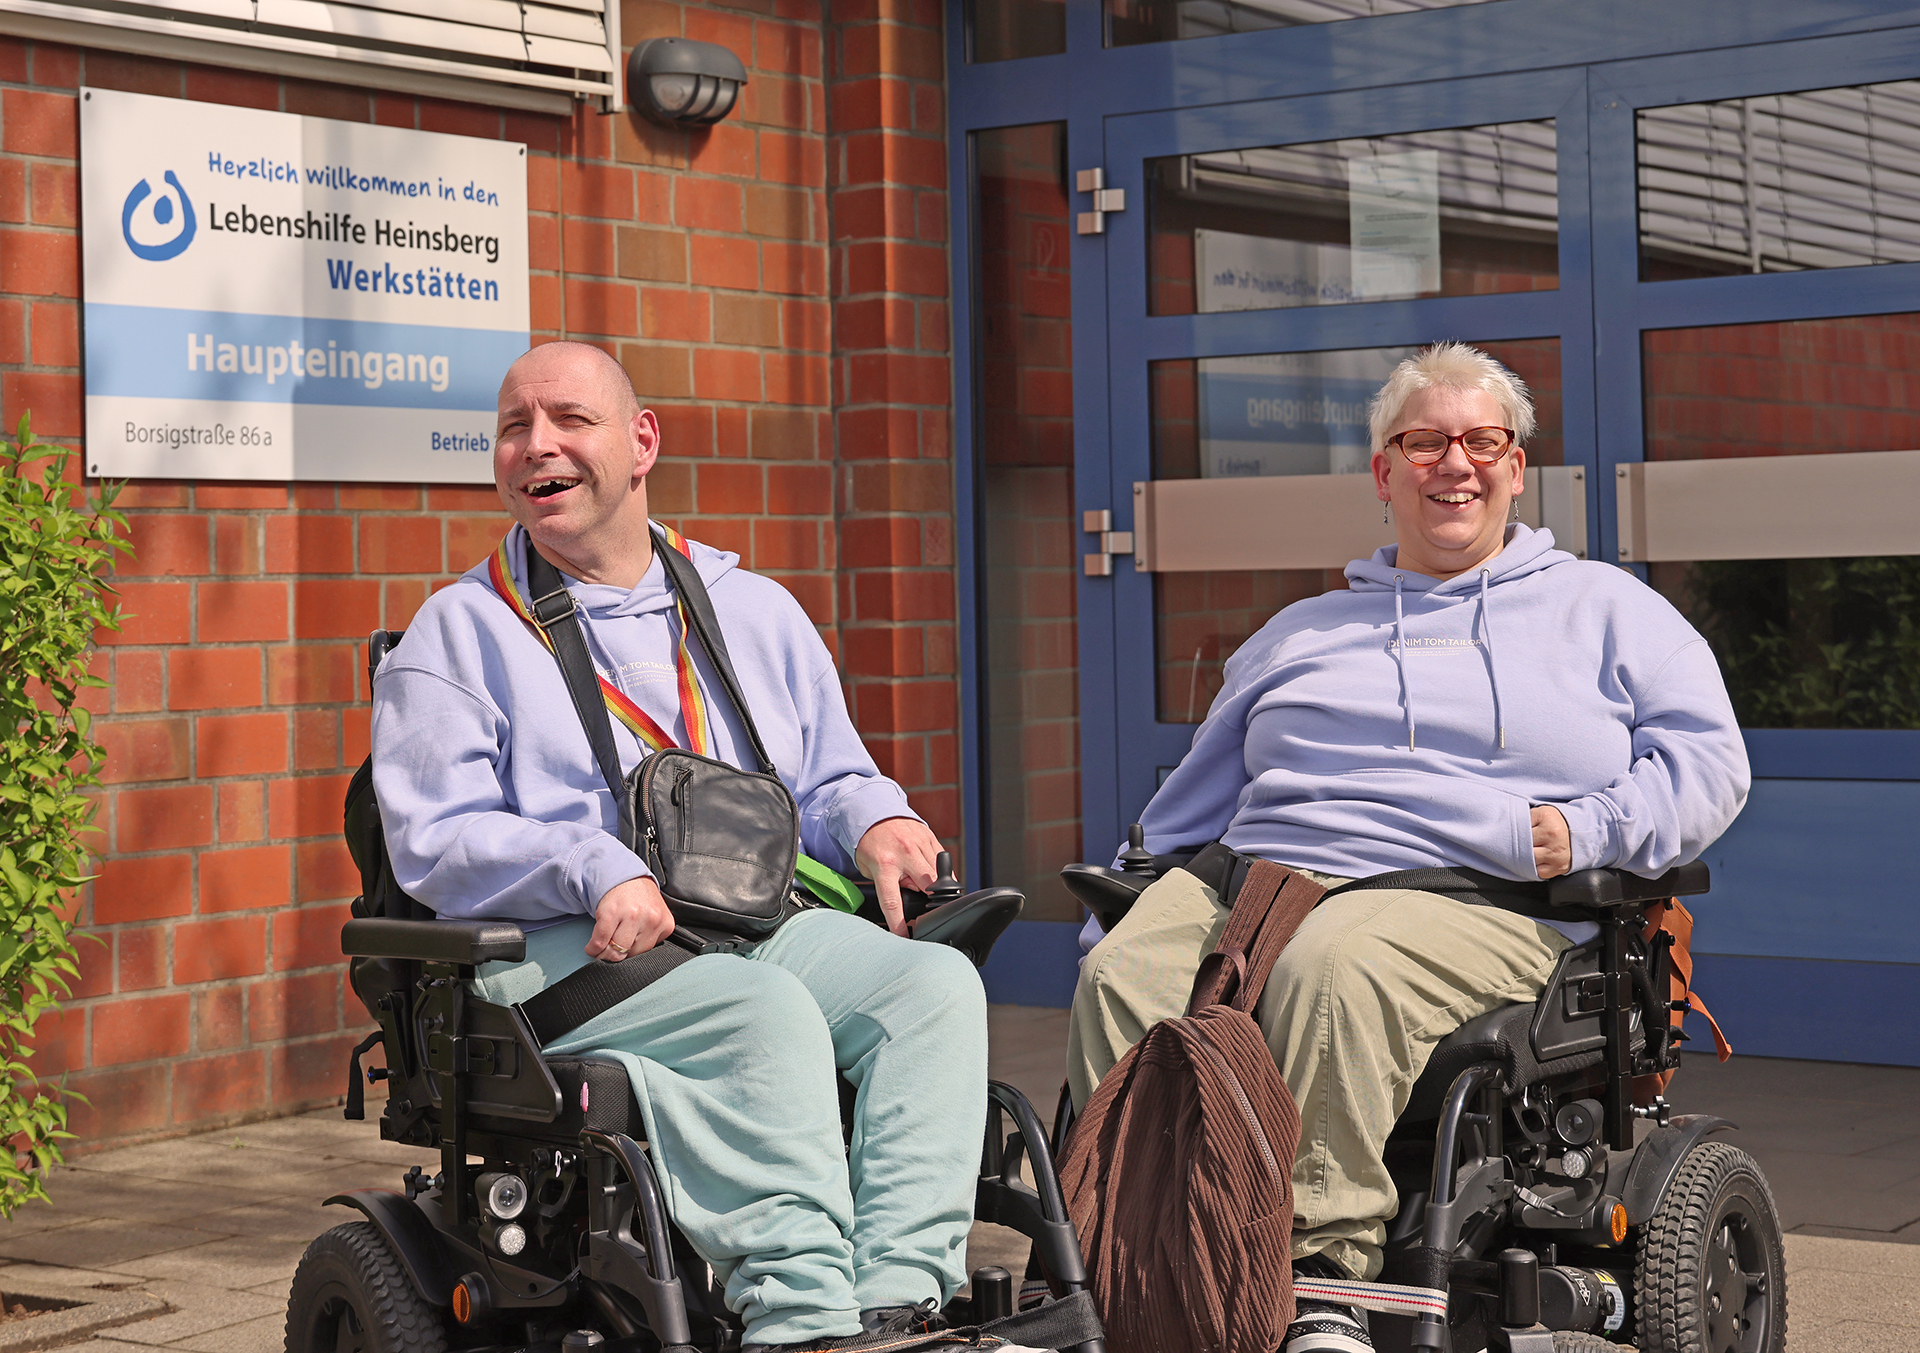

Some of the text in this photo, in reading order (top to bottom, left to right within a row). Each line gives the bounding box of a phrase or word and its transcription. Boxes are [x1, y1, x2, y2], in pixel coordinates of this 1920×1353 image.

[208, 152, 499, 207] Herzlich willkommen in den
[209, 202, 500, 263] Lebenshilfe Heinsberg
[327, 258, 500, 302] Werkstätten
[187, 332, 450, 392] Haupteingang
[126, 421, 236, 449] Borsigstraße
[431, 432, 490, 452] Betrieb
[1424, 638, 1445, 646] TOM
[1448, 638, 1482, 647] TAILOR
[630, 661, 650, 670] TOM
